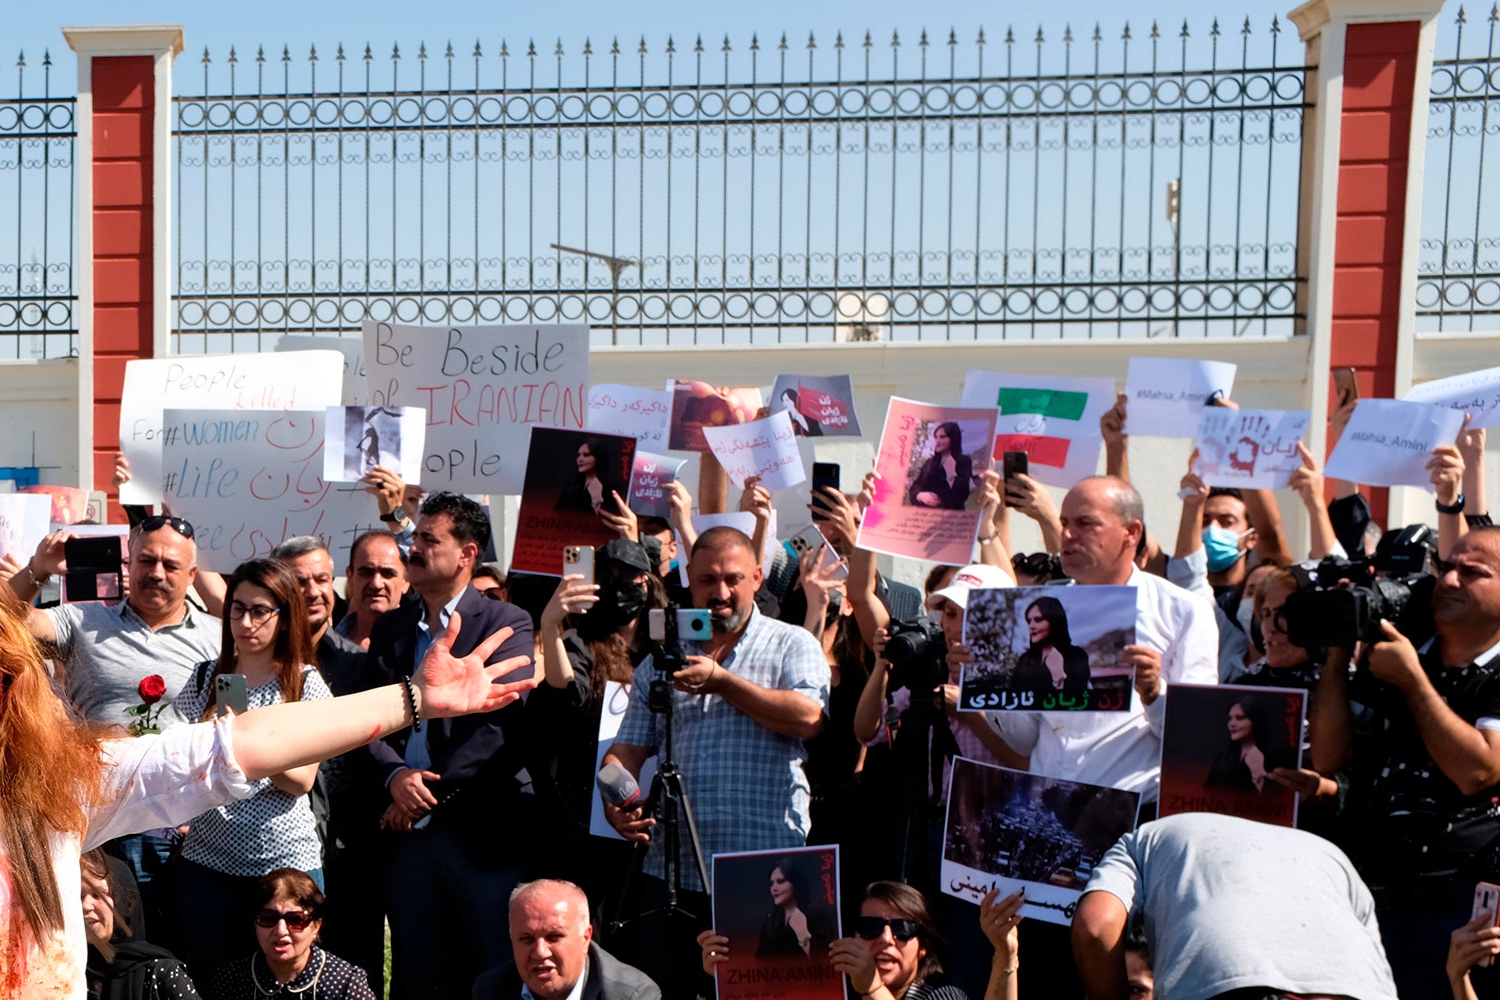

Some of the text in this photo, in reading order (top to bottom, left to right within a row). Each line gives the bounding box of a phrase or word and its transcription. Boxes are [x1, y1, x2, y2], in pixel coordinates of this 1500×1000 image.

[376, 322, 564, 376] Be Beside
[164, 363, 245, 394] People
[416, 378, 584, 429] IRANIAN
[165, 457, 239, 498] #Life
[421, 440, 501, 480] ople
[968, 690, 1125, 712] ژن ژیان ئازادی
[726, 965, 836, 985] ZHINA AMINI
